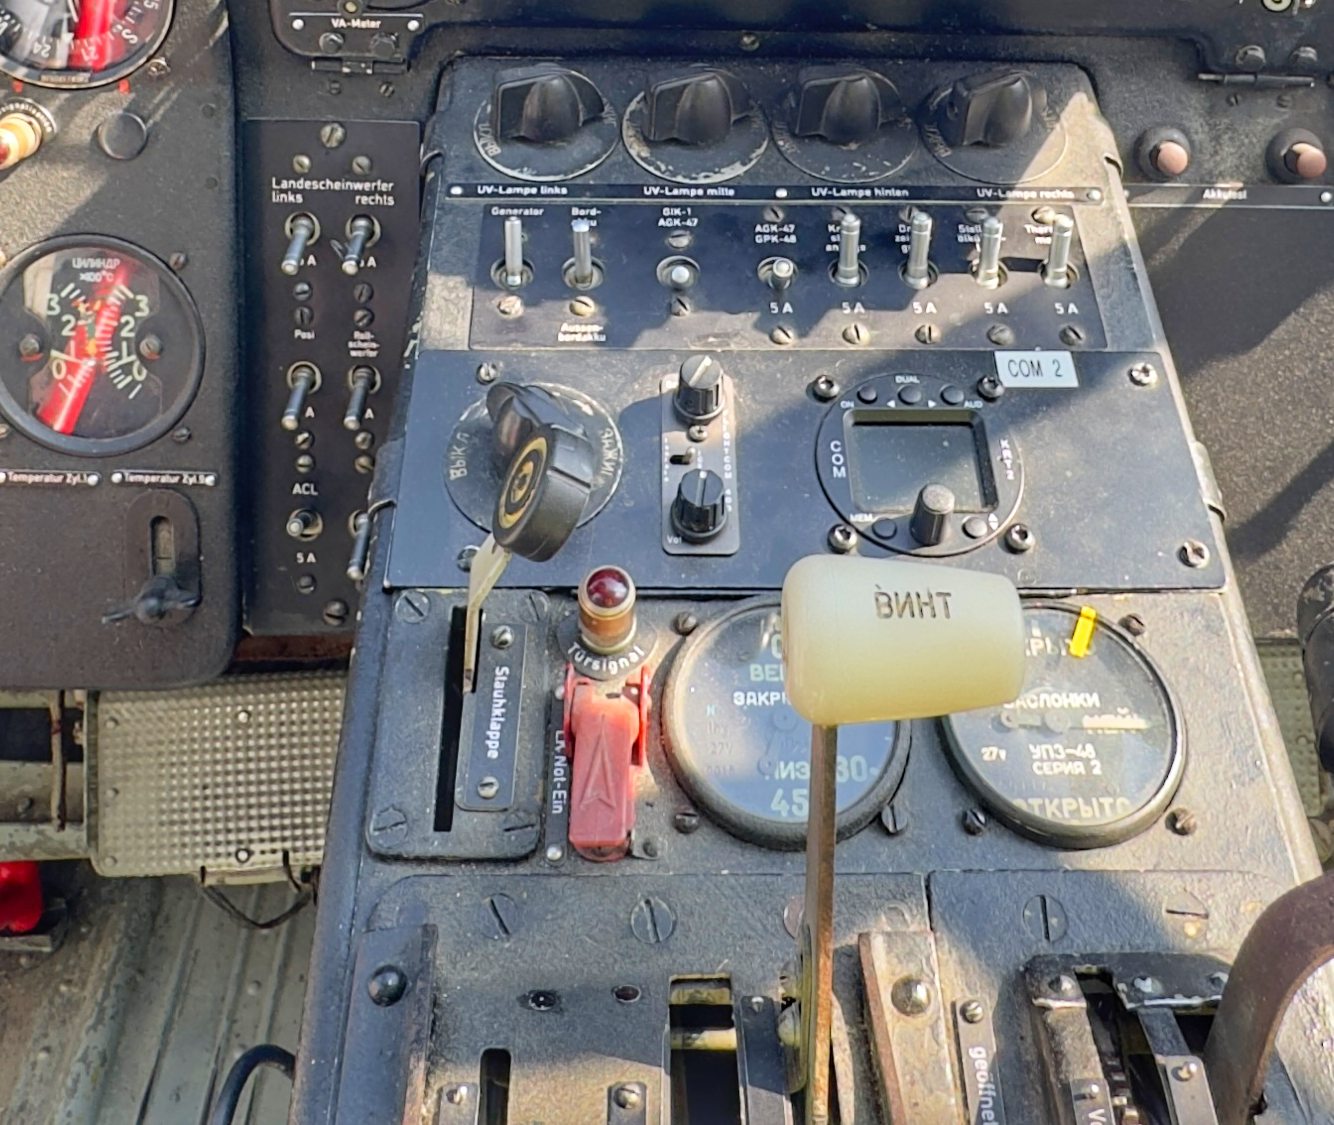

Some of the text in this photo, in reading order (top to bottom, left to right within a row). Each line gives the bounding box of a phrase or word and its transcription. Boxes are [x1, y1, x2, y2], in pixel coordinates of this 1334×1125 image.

[331, 18, 381, 29] VA-Meter
[272, 178, 394, 193] Landescheinwerfer
[477, 185, 567, 196] UV-Lampe links
[644, 187, 735, 197] UV-Lampe mitte
[812, 187, 908, 199] UV-Lampe hinten
[977, 188, 1036, 201] UV-Lampe
[272, 191, 395, 206] links rechts
[492, 207, 544, 216] Generator
[572, 207, 601, 217] Bord-
[662, 208, 691, 216] GIK-1
[658, 218, 698, 228] AGK-47
[755, 224, 795, 234] AGK-47
[73, 258, 120, 270] ЦИЛИНДР
[561, 324, 603, 333] Aussen-
[558, 332, 606, 342] bordakku
[1008, 361, 1063, 377] COM 2
[830, 440, 846, 478] COM
[8, 472, 63, 485] Temperatur
[124, 472, 179, 484] Temperatur
[292, 483, 318, 496] ACL
[850, 514, 873, 522] MEM
[875, 589, 952, 619] ВИНТ
[567, 643, 645, 674] Türsignal
[1033, 760, 1102, 774] СЕРИЯ 2
[551, 755, 567, 814] Not-Ein
